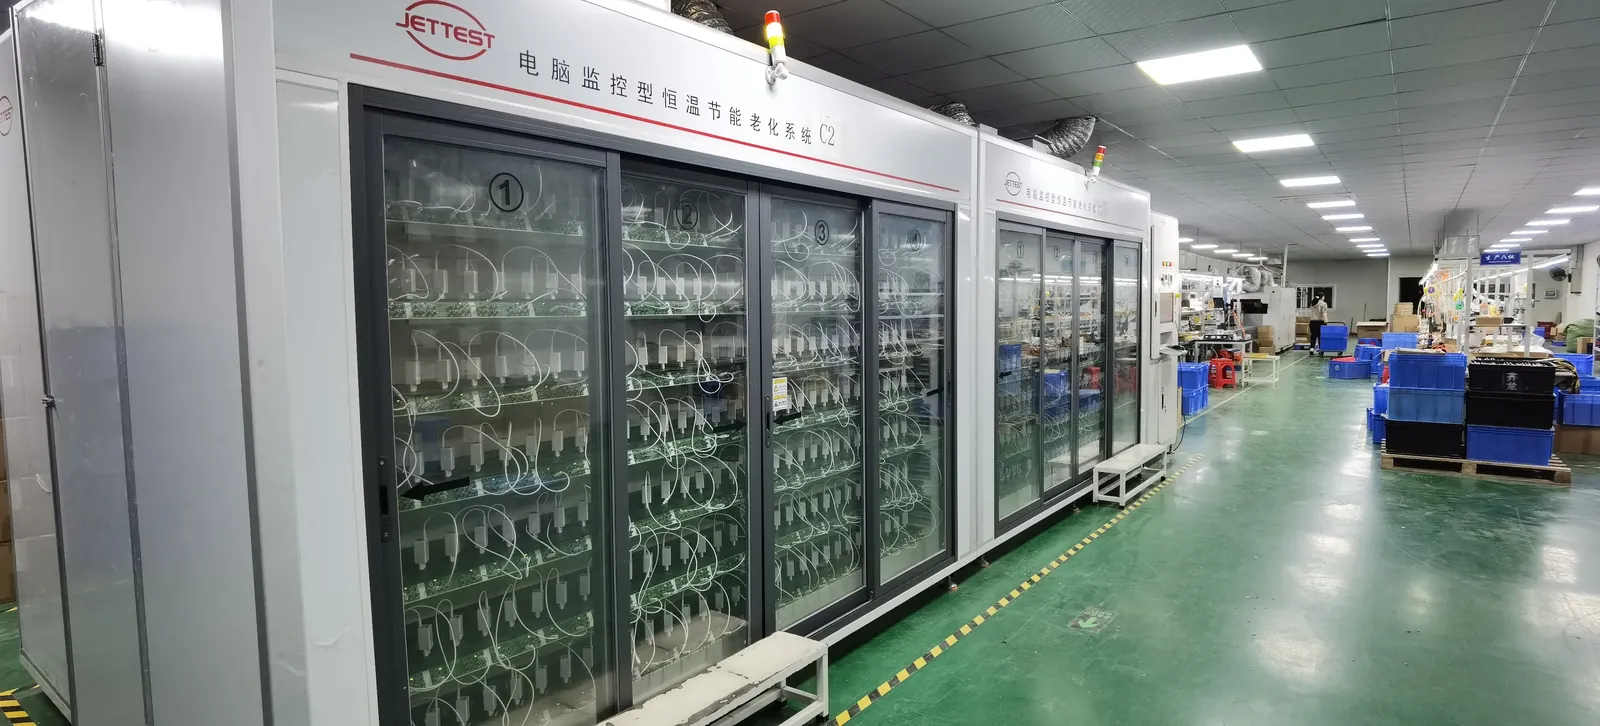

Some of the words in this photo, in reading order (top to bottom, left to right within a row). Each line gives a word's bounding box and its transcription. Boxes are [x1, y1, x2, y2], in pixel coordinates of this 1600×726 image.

[396, 12, 495, 49] JETTEST
[519, 50, 811, 144] 电脑监控型恒温节能老化系统
[819, 124, 835, 146] C2
